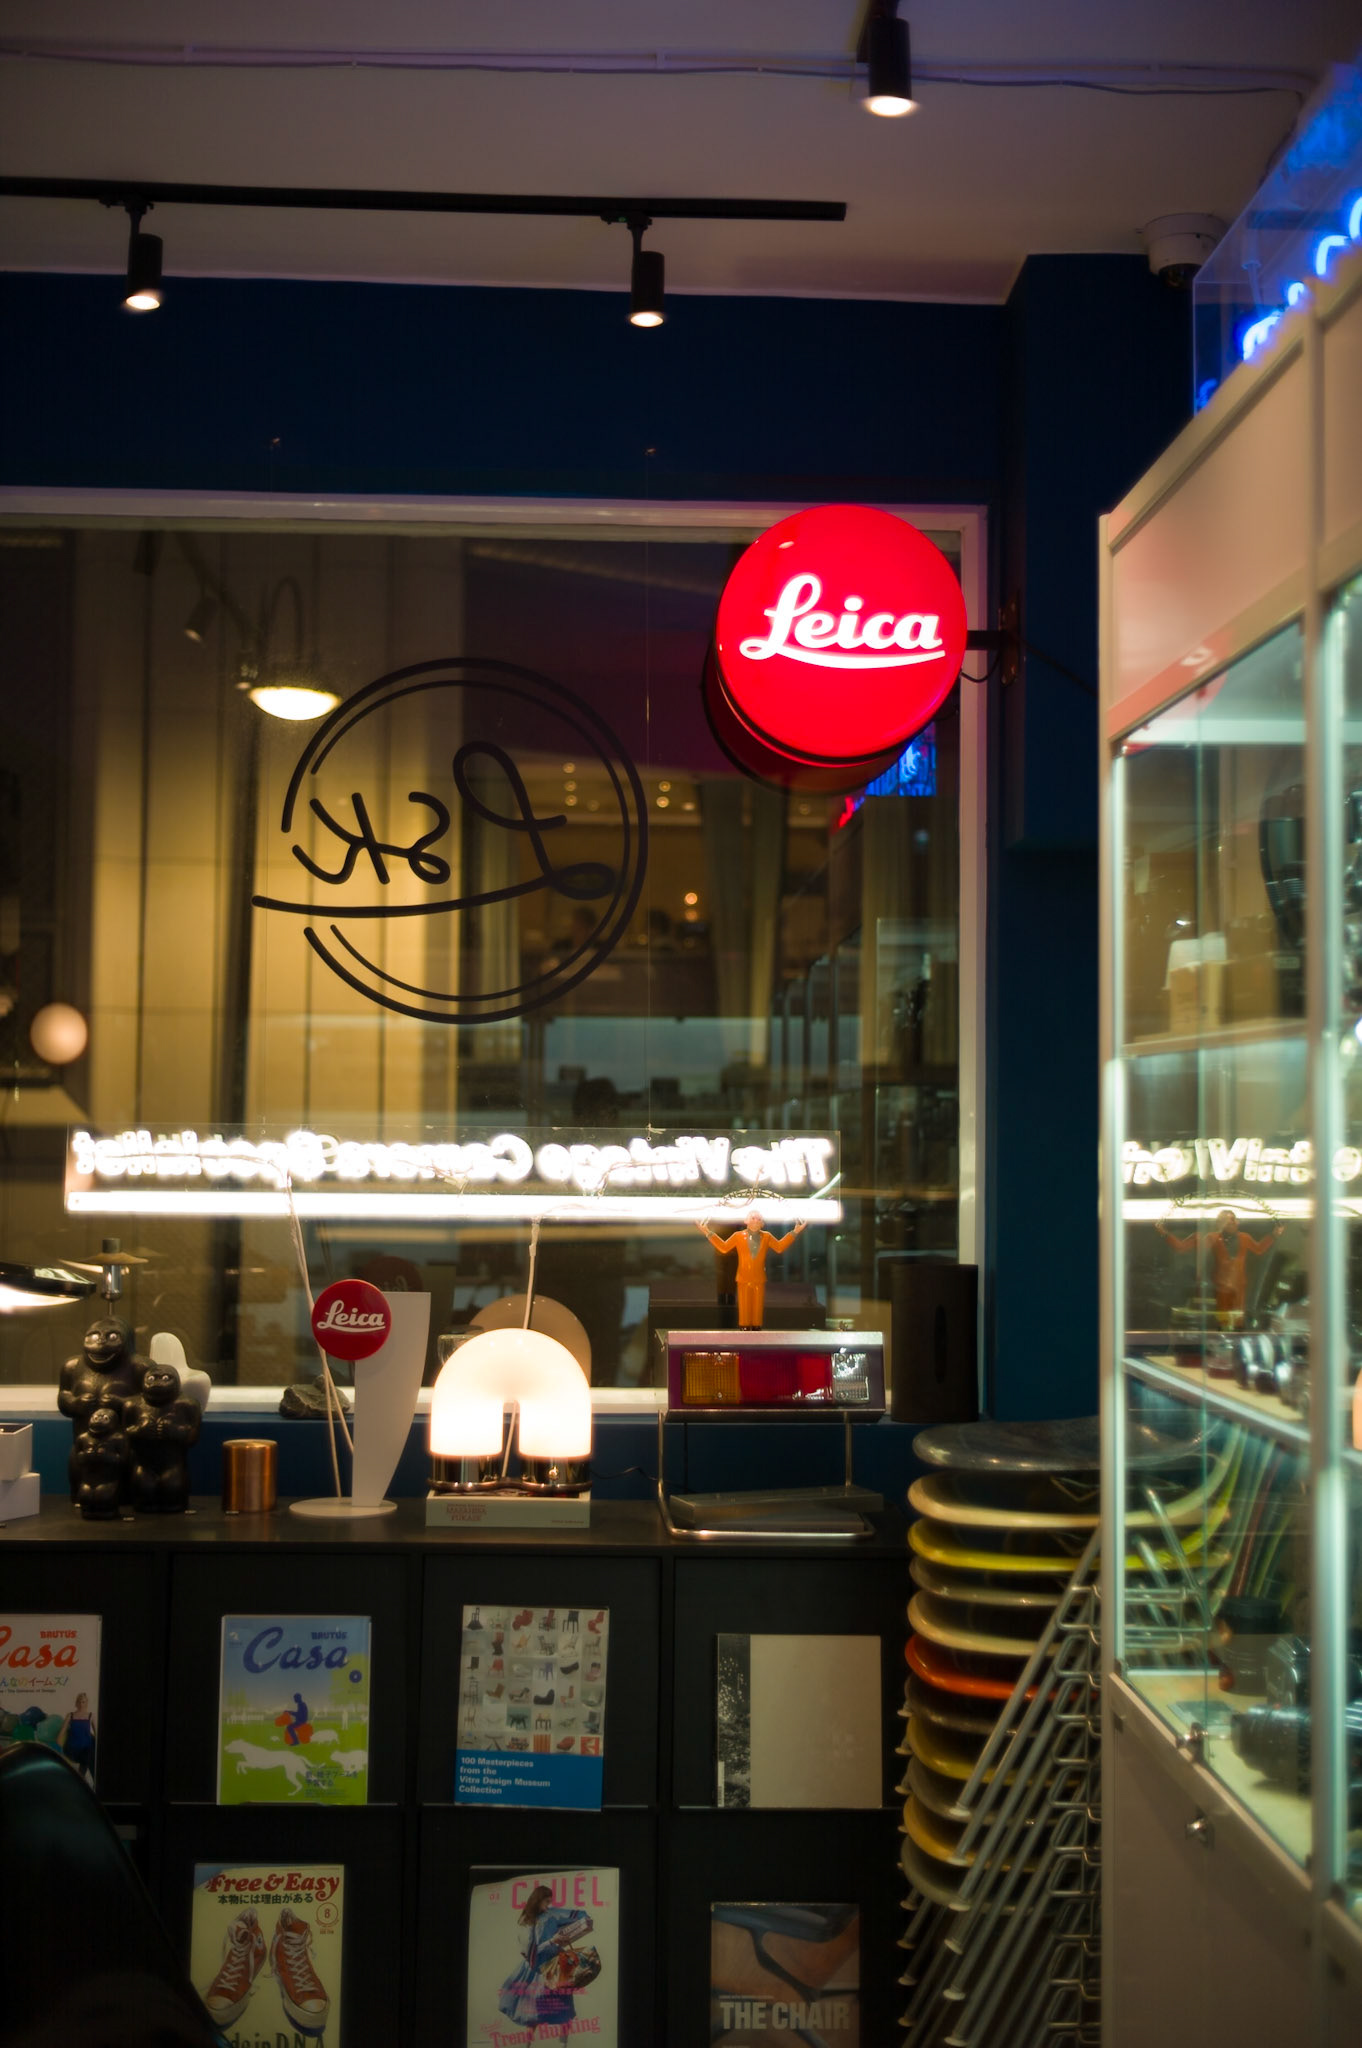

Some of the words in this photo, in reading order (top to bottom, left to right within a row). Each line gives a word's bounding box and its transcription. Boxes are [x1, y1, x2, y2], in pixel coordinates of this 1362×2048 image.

[740, 573, 946, 670] Leica
[317, 1299, 386, 1333] Leica
[40, 1630, 77, 1639] BRUTUS
[311, 1631, 348, 1640] BRUTUS
[242, 1626, 350, 1674] Casa
[461, 1756, 476, 1765] 100
[478, 1757, 534, 1769] Masterpieces
[459, 1766, 481, 1775] from
[483, 1767, 497, 1775] the
[459, 1775, 481, 1785] Vitra
[482, 1776, 512, 1787] Design
[514, 1778, 551, 1788] Museum
[459, 1785, 503, 1795] Collection
[206, 1872, 340, 1902] Free&Easy
[512, 1872, 605, 1910] CUÉL
[218, 1893, 314, 1905] 本物には理由がある
[719, 2002, 768, 2030] THE
[771, 2002, 850, 2030] CHAIR
